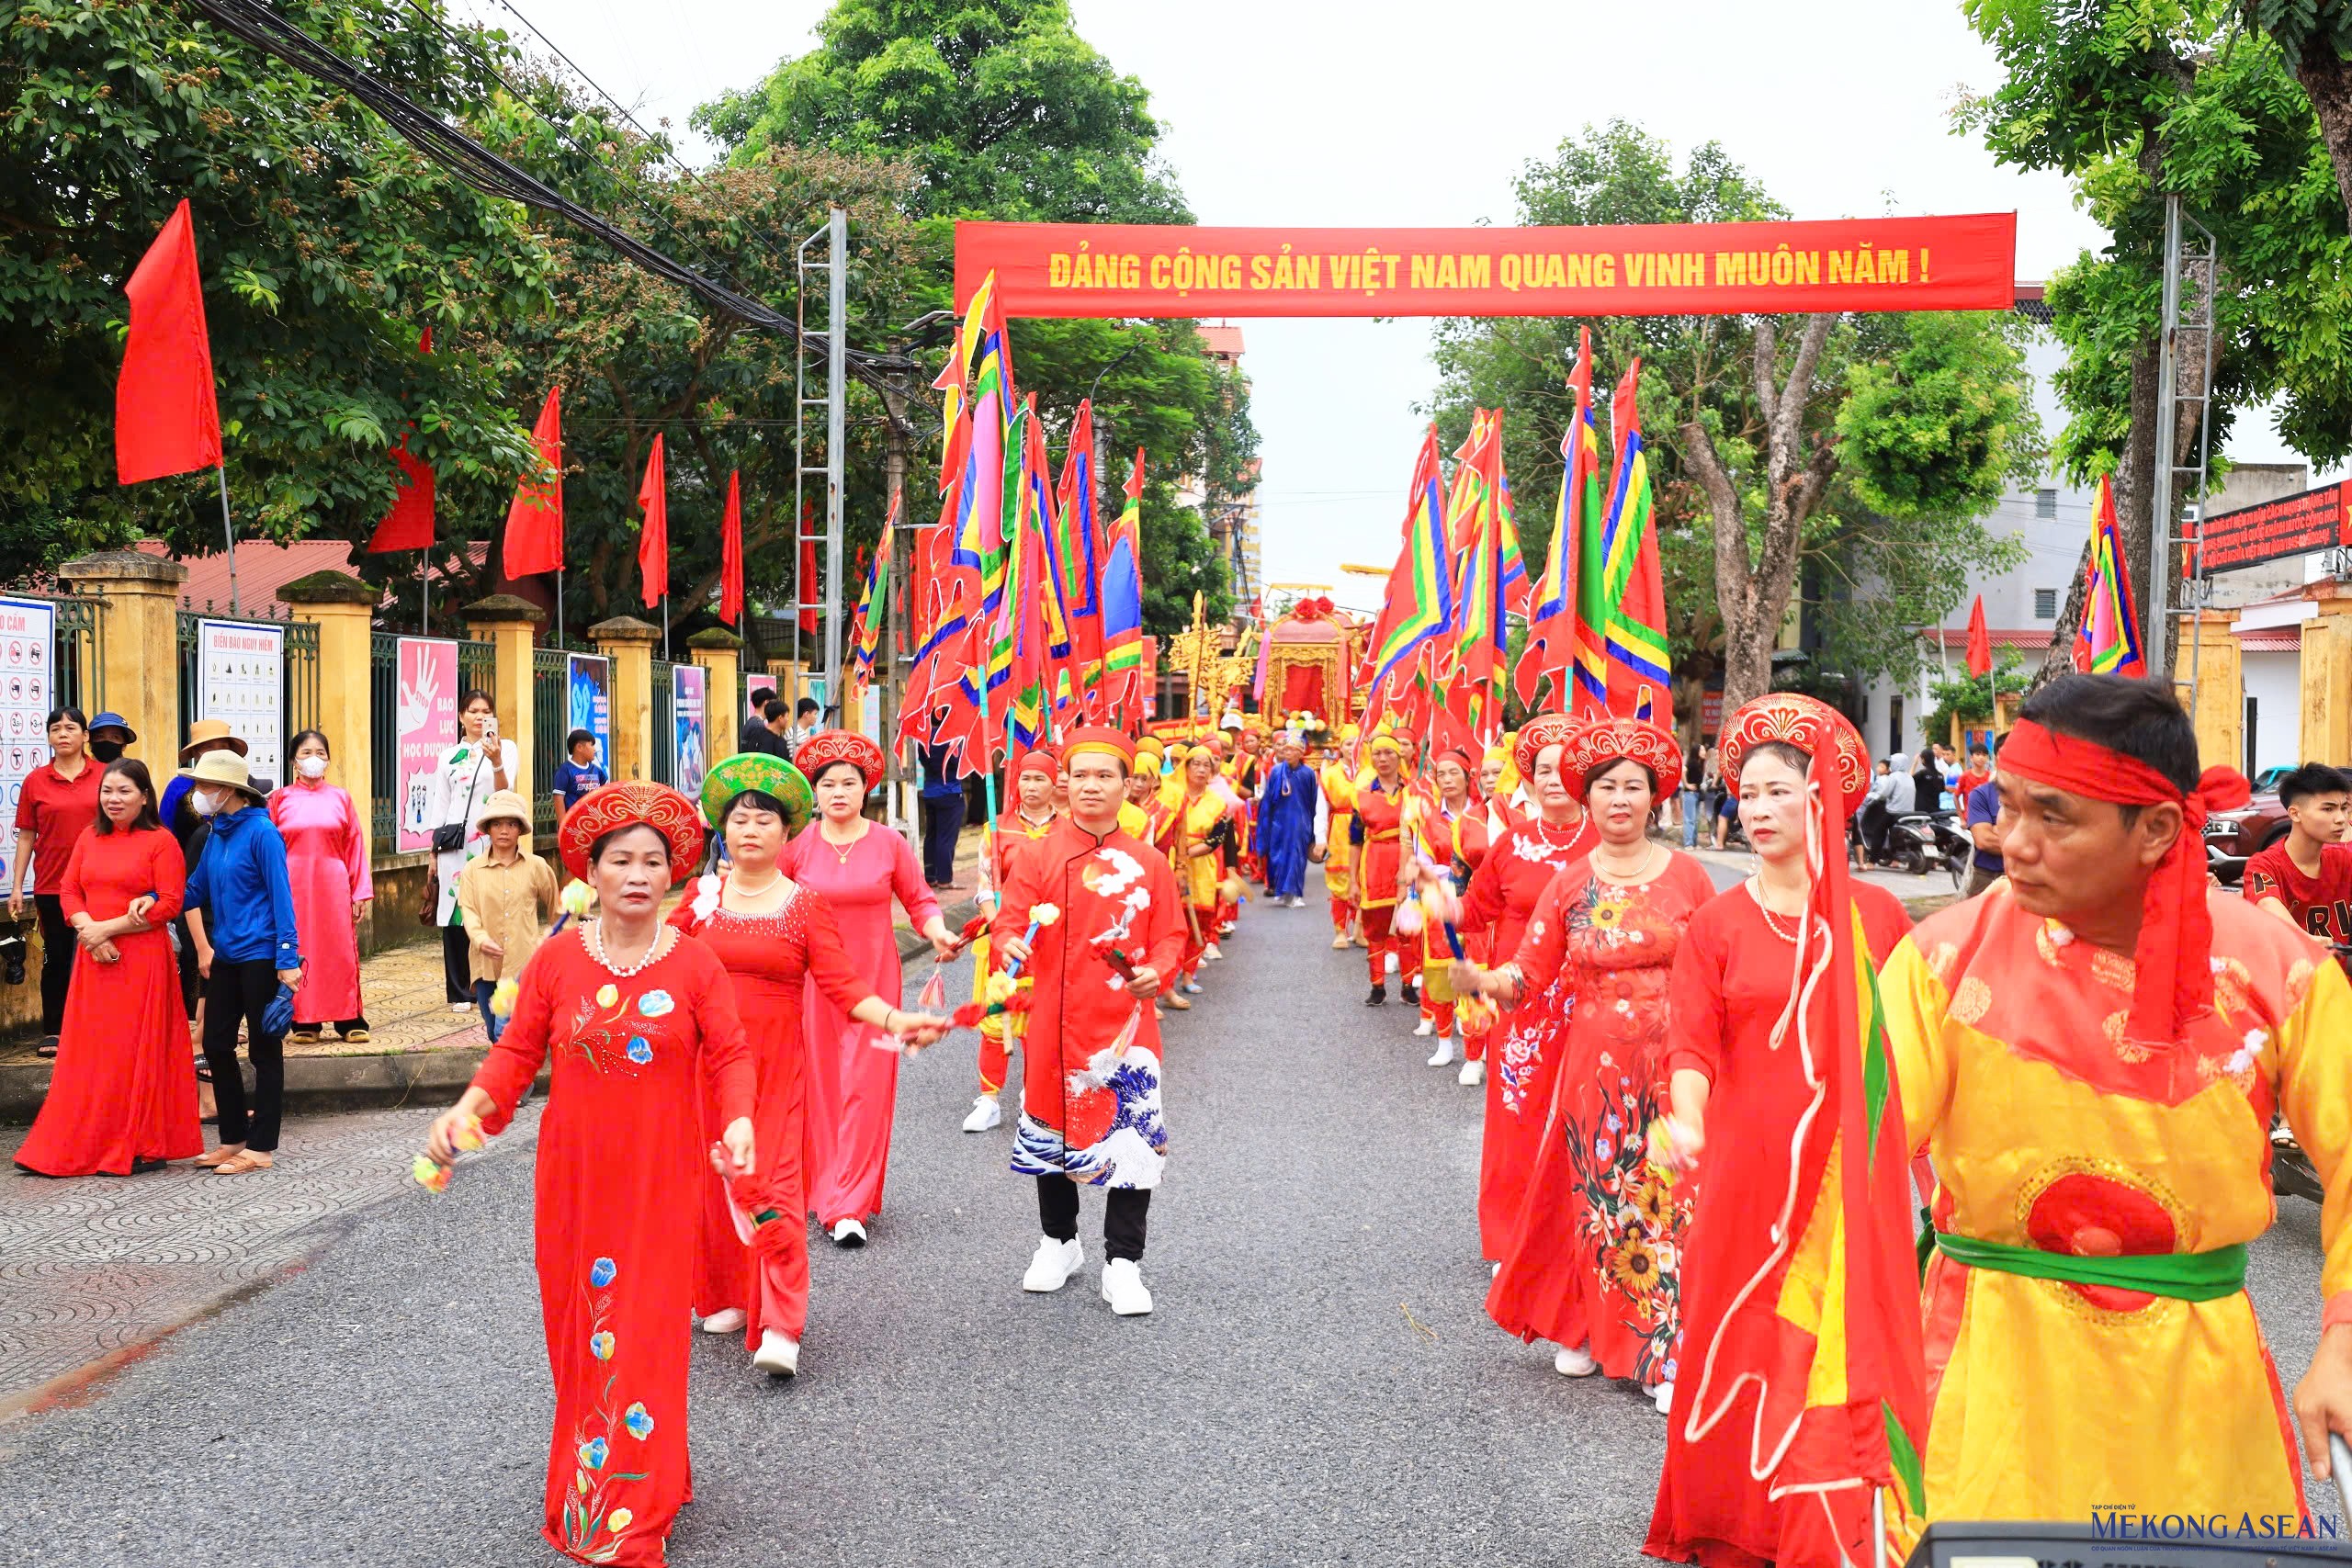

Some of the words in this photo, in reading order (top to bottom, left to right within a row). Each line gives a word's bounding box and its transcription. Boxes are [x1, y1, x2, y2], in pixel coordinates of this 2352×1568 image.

[1049, 240, 1140, 288] ĐẢNG
[1150, 247, 1241, 297] CỘNG
[1250, 243, 1319, 289] SẢN
[1329, 248, 1400, 296] VIỆT
[1410, 254, 1490, 288] NAM
[1499, 254, 1616, 292] QUANG
[1623, 253, 1705, 287] VINH
[1714, 243, 1820, 287] MUÔN
[1828, 242, 1909, 285] NĂM
[1919, 248, 1929, 283] !
[415, 691, 429, 709] STOP
[436, 697, 455, 716] BẠO
[403, 742, 422, 761] HỌC
